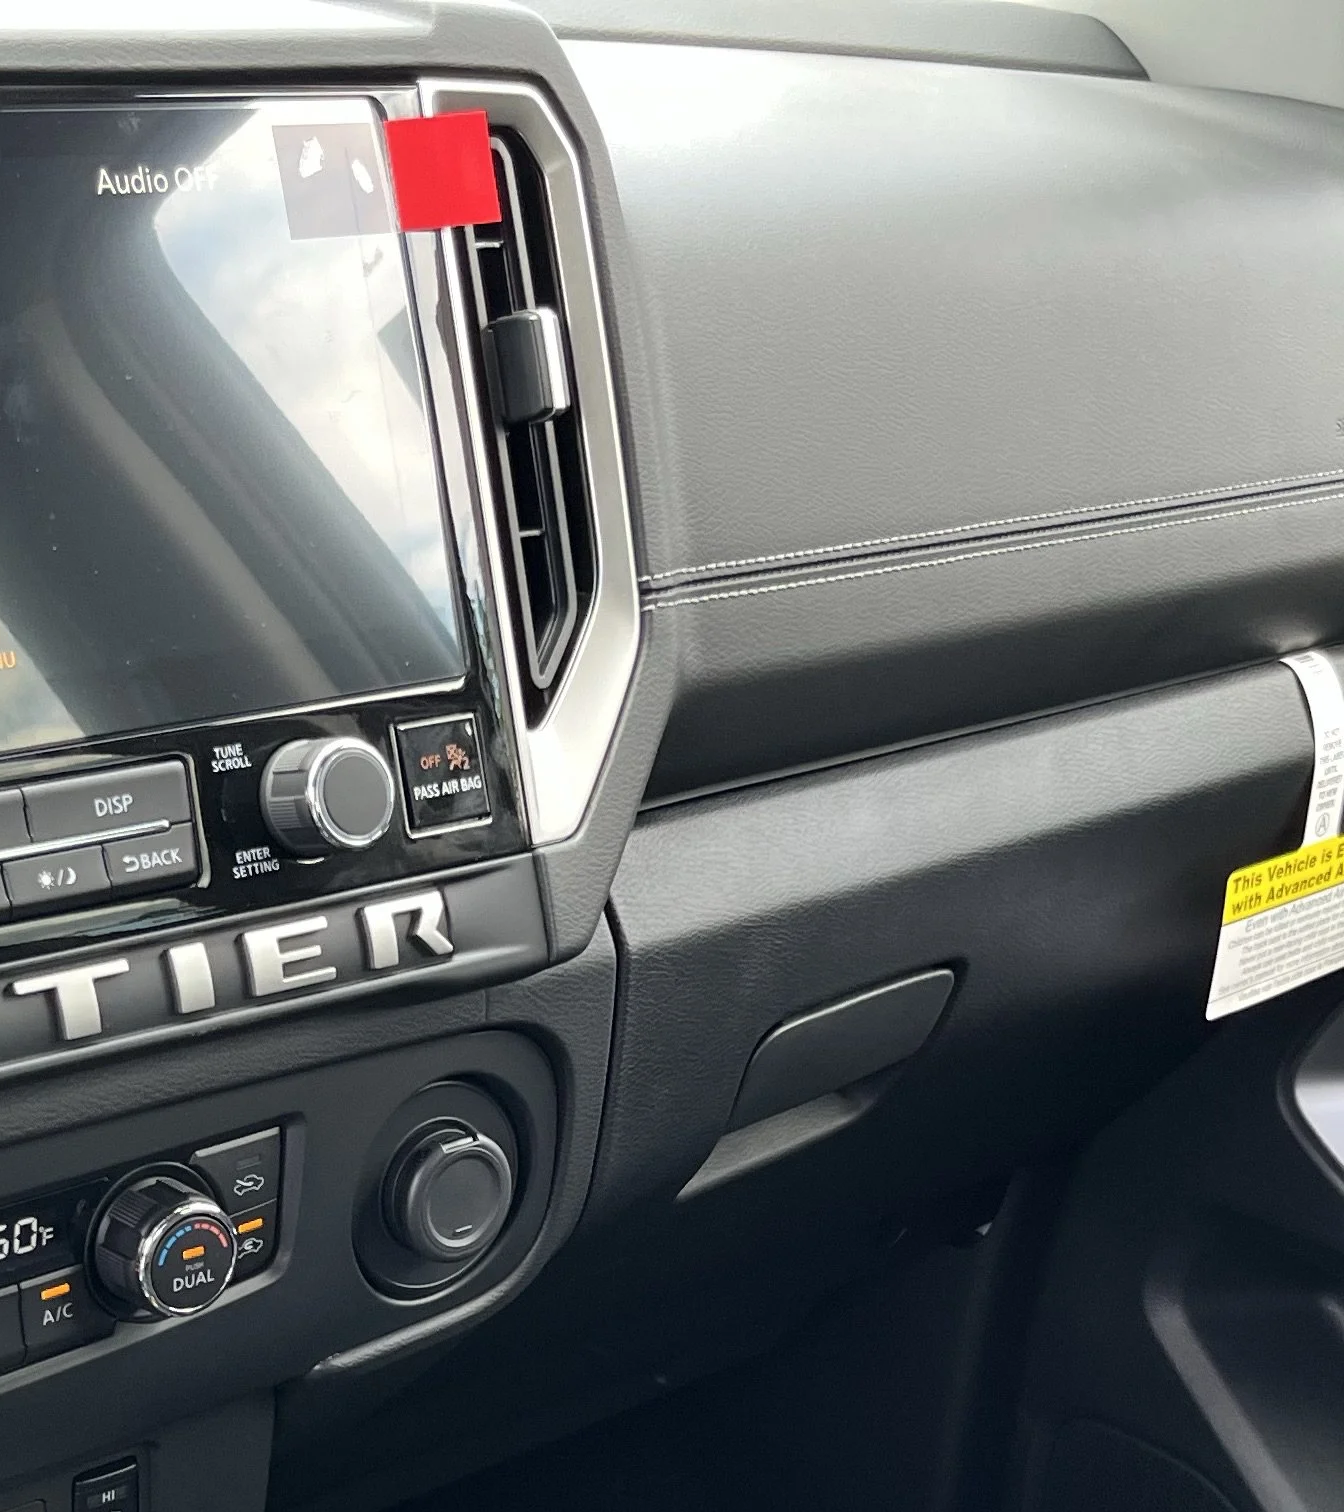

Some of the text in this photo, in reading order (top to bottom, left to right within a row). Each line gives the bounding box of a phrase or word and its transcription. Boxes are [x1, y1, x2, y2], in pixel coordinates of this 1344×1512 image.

[97, 166, 218, 197] Audio OFF
[213, 743, 244, 757] TUNE
[211, 754, 252, 773] SCROLL
[420, 755, 441, 770] OFF
[413, 775, 482, 800] PASS AIR BAG
[95, 794, 134, 817] DISP
[141, 846, 182, 869] BACK
[235, 847, 271, 865] ENTER
[232, 859, 280, 880] SETTING
[1232, 873, 1262, 894] This
[1267, 854, 1317, 881] Vehicle
[1321, 849, 1332, 863] is
[1232, 893, 1262, 916] with
[1266, 867, 1333, 904] Advanced
[172, 1273, 215, 1293] DUAL
[42, 1303, 73, 1326] A/C
[101, 1489, 116, 1503] HI
